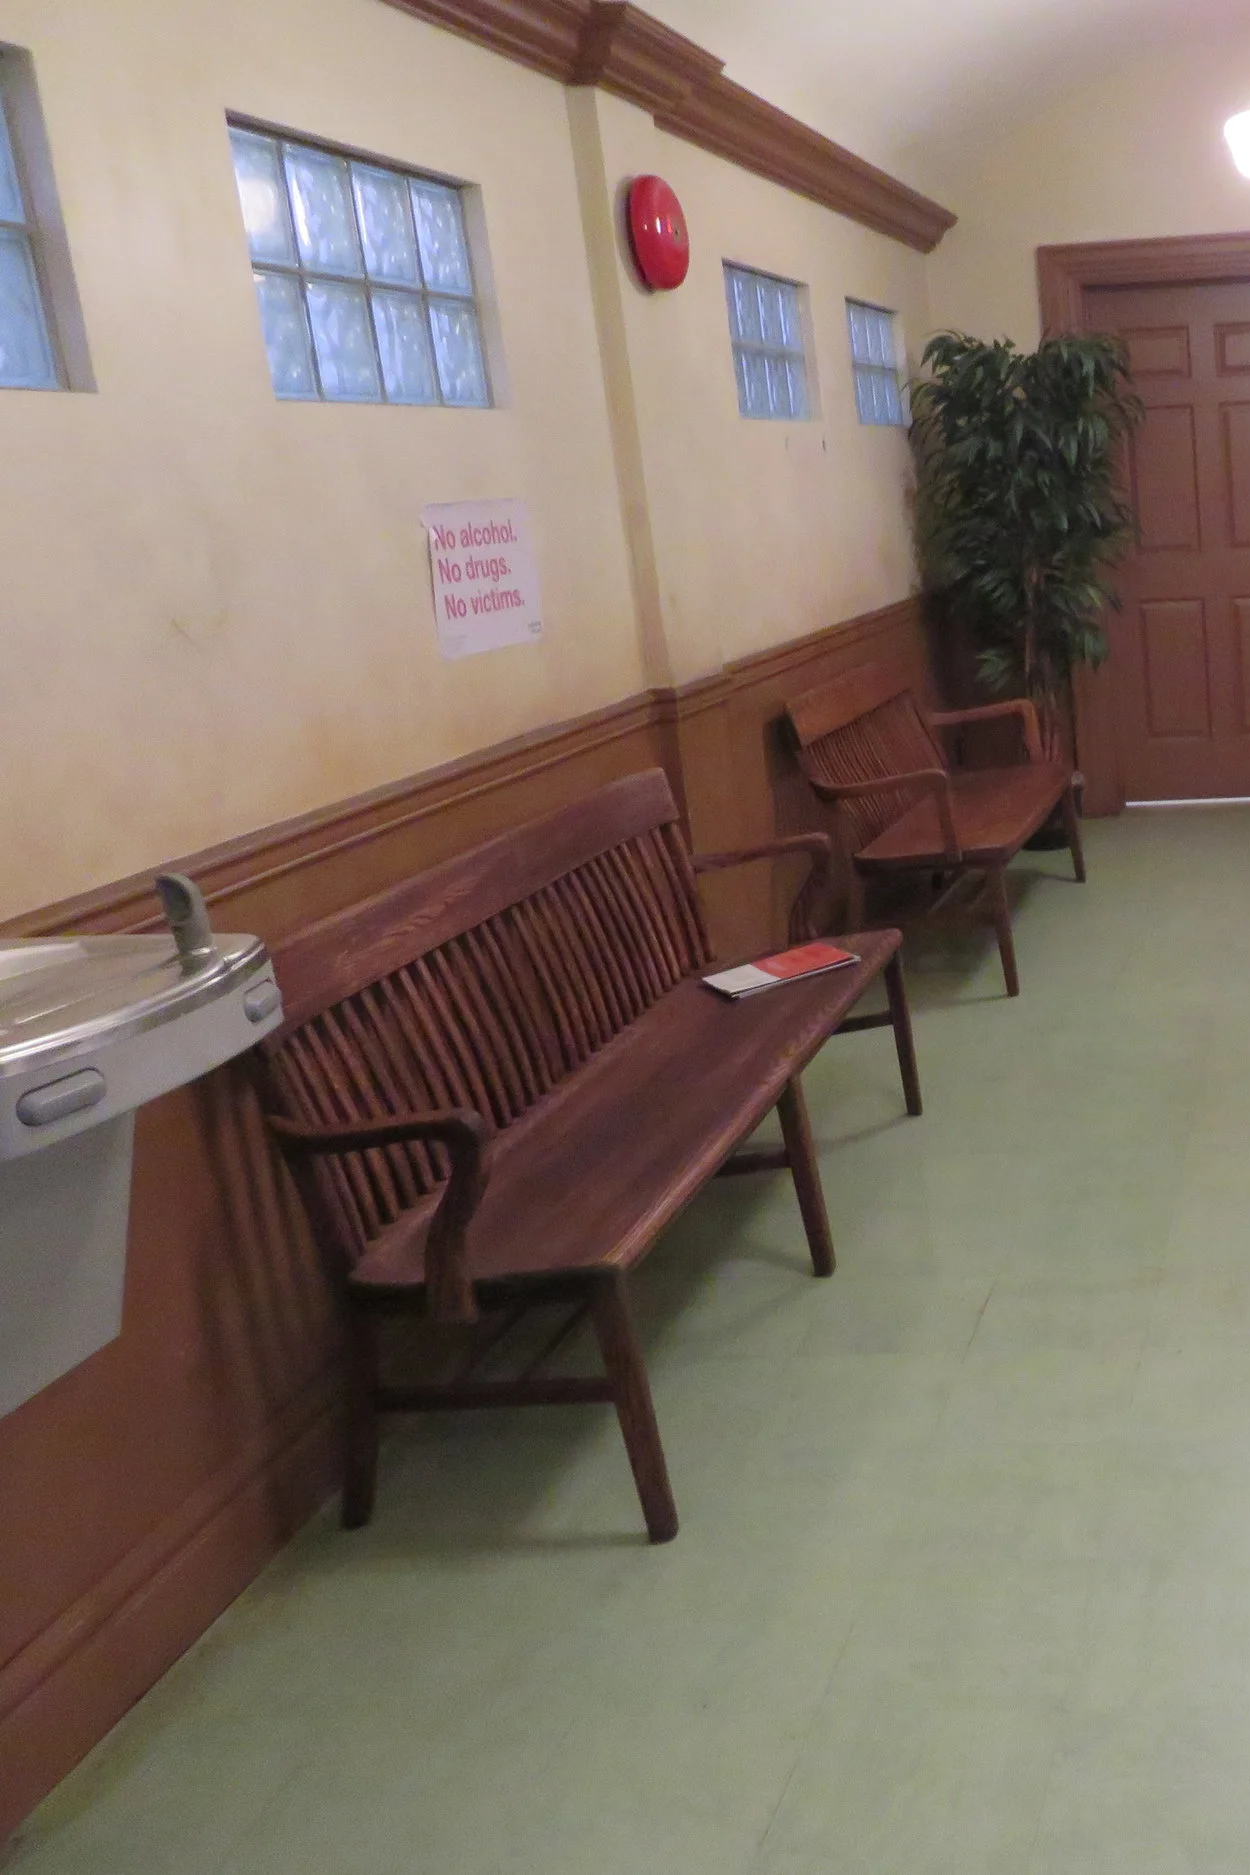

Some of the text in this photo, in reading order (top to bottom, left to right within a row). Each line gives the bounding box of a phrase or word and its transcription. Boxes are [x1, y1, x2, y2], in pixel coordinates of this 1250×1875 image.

[433, 519, 517, 550] No alcohol.
[438, 555, 511, 584] No drugs.
[444, 588, 525, 620] No victims.
